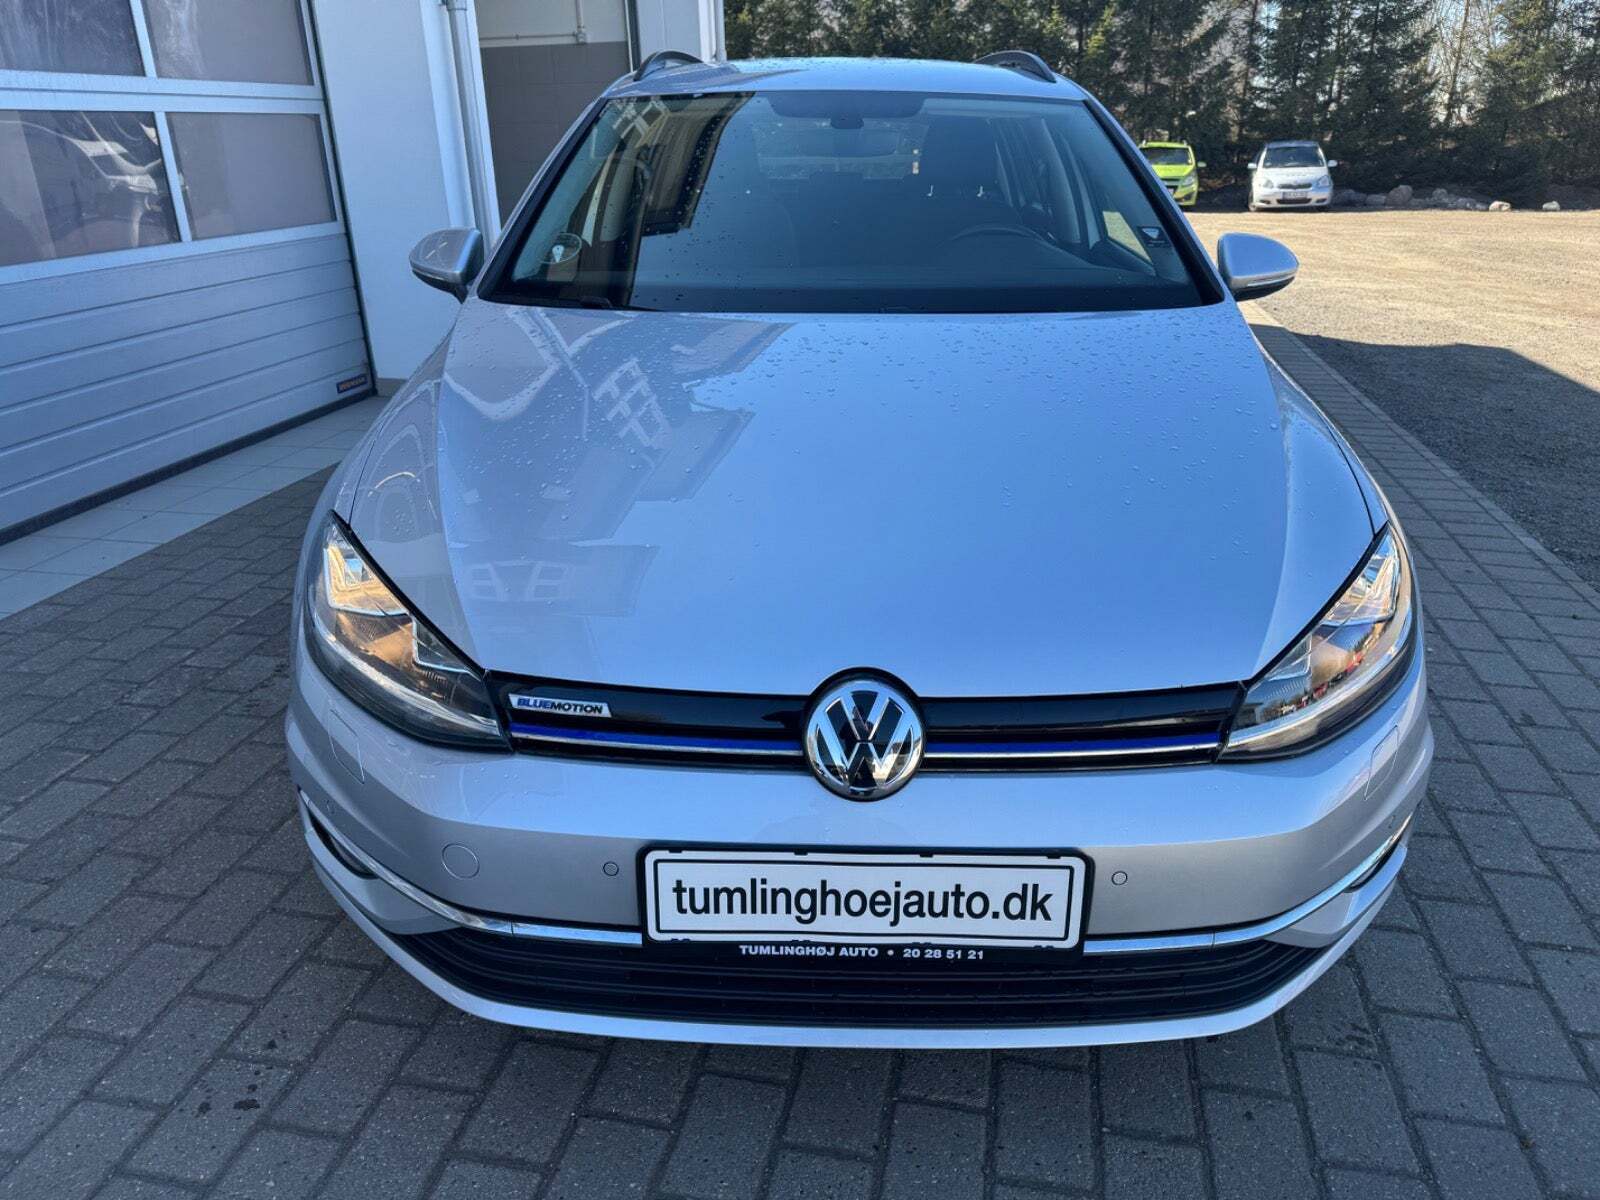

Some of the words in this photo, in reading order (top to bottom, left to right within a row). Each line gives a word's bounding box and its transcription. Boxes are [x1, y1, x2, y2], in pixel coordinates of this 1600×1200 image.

[518, 697, 603, 714] BLUEMOTION
[672, 877, 1052, 927] tumlinghoejauto.dk
[739, 944, 835, 957] TUMLINGHØJ
[839, 946, 879, 957] AUTO
[903, 948, 920, 958] 20
[924, 948, 942, 959] 28
[946, 949, 962, 959] 51
[967, 949, 984, 960] 21
